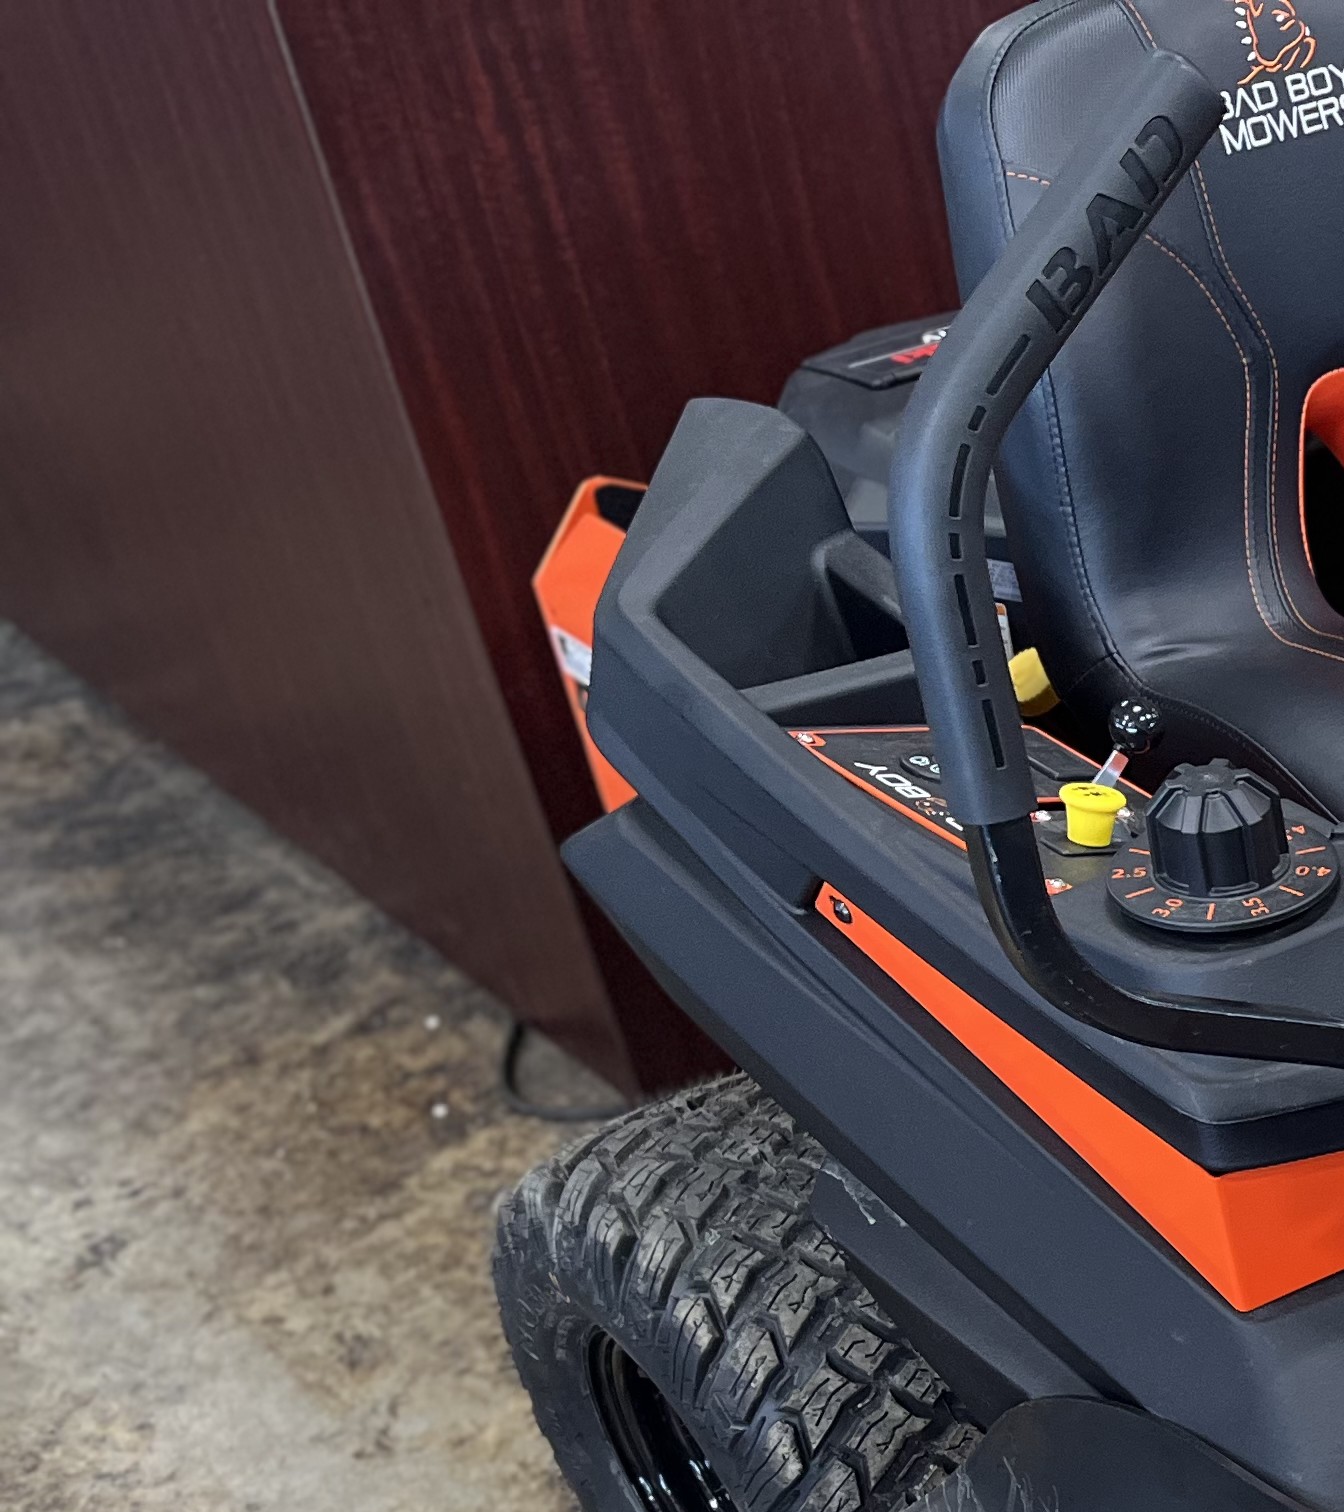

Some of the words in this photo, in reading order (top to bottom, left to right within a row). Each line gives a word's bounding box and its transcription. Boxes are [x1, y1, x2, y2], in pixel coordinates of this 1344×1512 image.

[1025, 115, 1185, 335] BAD
[853, 761, 931, 798] BOY
[1111, 867, 1147, 879] 2.5
[1295, 865, 1332, 877] 4.0
[1151, 898, 1183, 918] 3.0
[1242, 897, 1271, 917] 3.5
